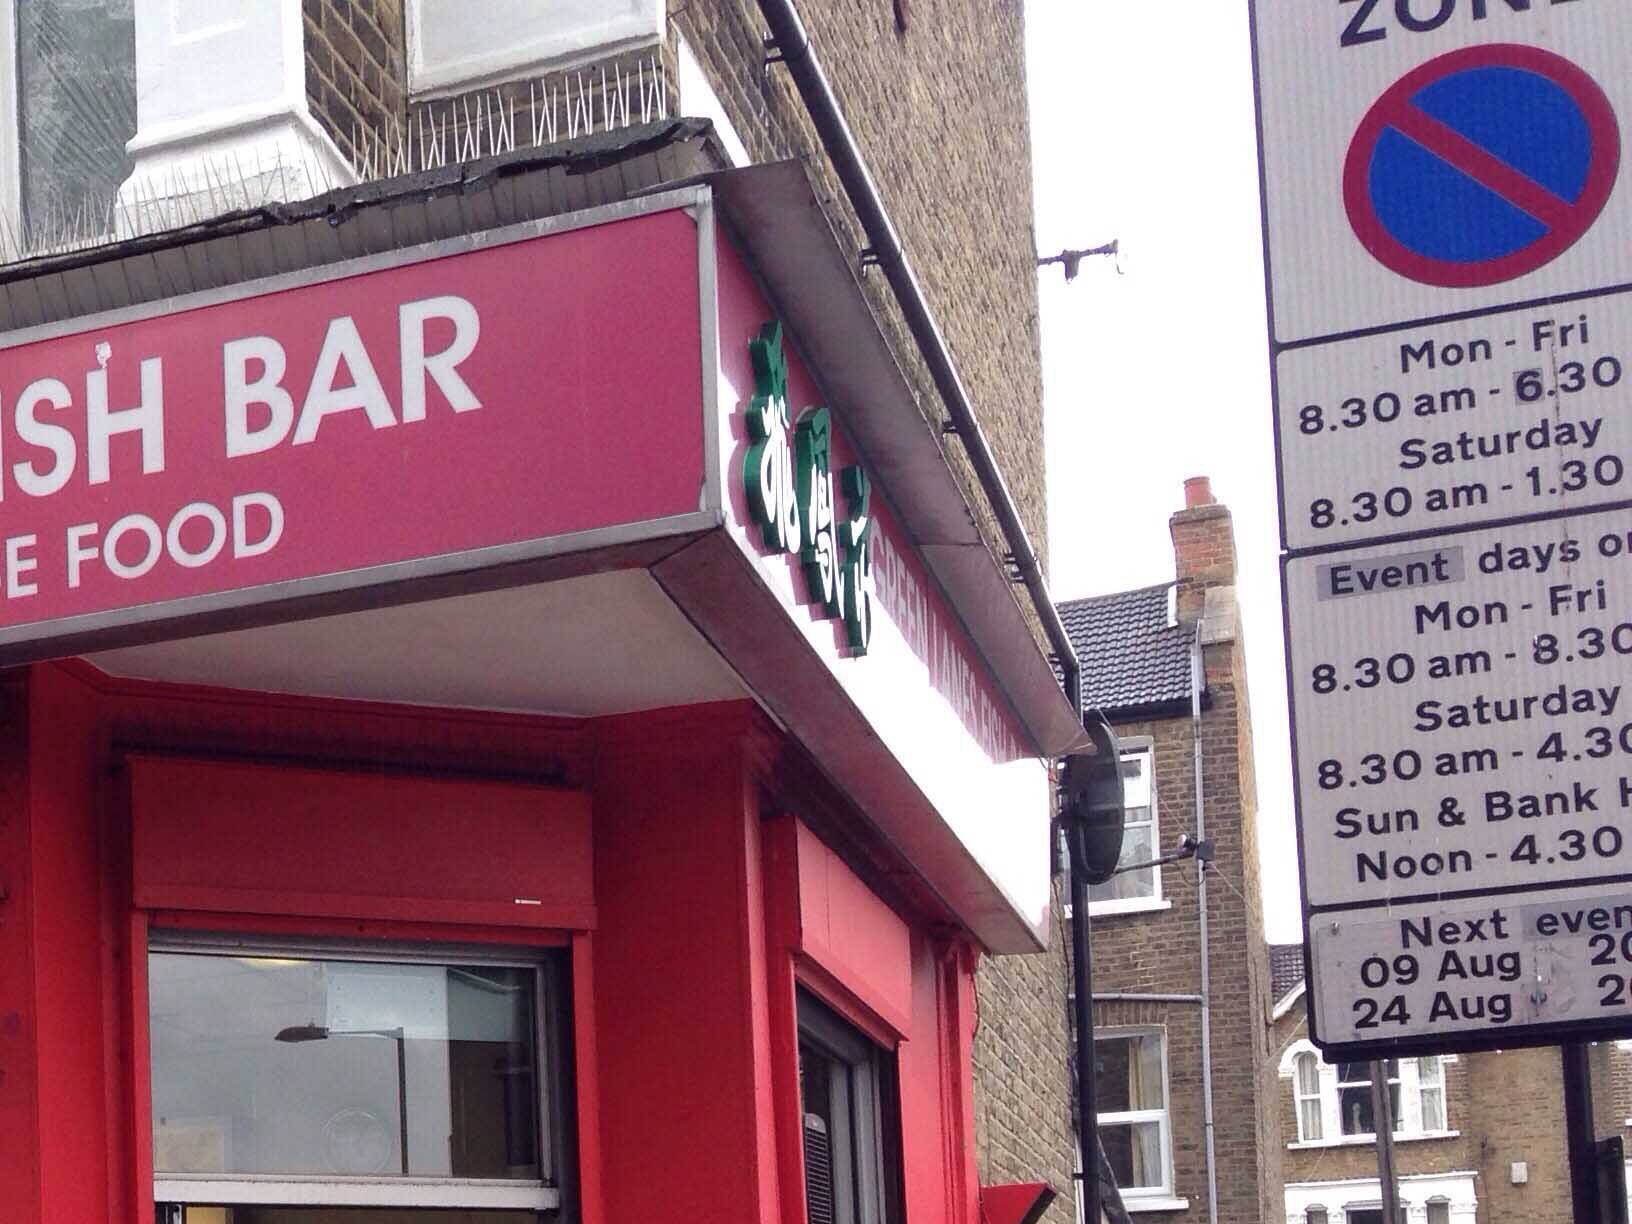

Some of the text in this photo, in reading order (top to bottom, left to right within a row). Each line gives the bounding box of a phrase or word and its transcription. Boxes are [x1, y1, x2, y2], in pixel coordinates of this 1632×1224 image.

[1340, 0, 1581, 47] ZO
[1400, 334, 1493, 374] Mon
[1532, 314, 1590, 352] Fri
[223, 295, 482, 458] BAR
[1299, 391, 1402, 435] 8.30
[1414, 386, 1477, 417] am
[1515, 356, 1623, 402] 6.30
[1399, 417, 1603, 470] Saturday
[1310, 485, 1413, 530] 8.30
[1425, 480, 1488, 512] am
[1525, 455, 1624, 498] 1.30
[67, 491, 285, 588] FOOD
[1329, 531, 1632, 596] Event days o
[1415, 600, 1508, 635] Mon
[1549, 579, 1607, 616] Fri
[1311, 652, 1415, 694] 8.30
[1428, 649, 1492, 681] am
[1414, 684, 1621, 732] Saturday
[1317, 749, 1421, 790] 8.30
[1434, 746, 1498, 777] am
[1334, 803, 1420, 839] Sun
[1437, 797, 1466, 828] &
[1485, 781, 1599, 822] Bank
[1356, 846, 1472, 883] Noon
[1510, 825, 1623, 865] 4.30
[1401, 909, 1509, 949] Next
[1360, 950, 1521, 988] 09 Aug
[1353, 991, 1512, 1029] 24 Aug
